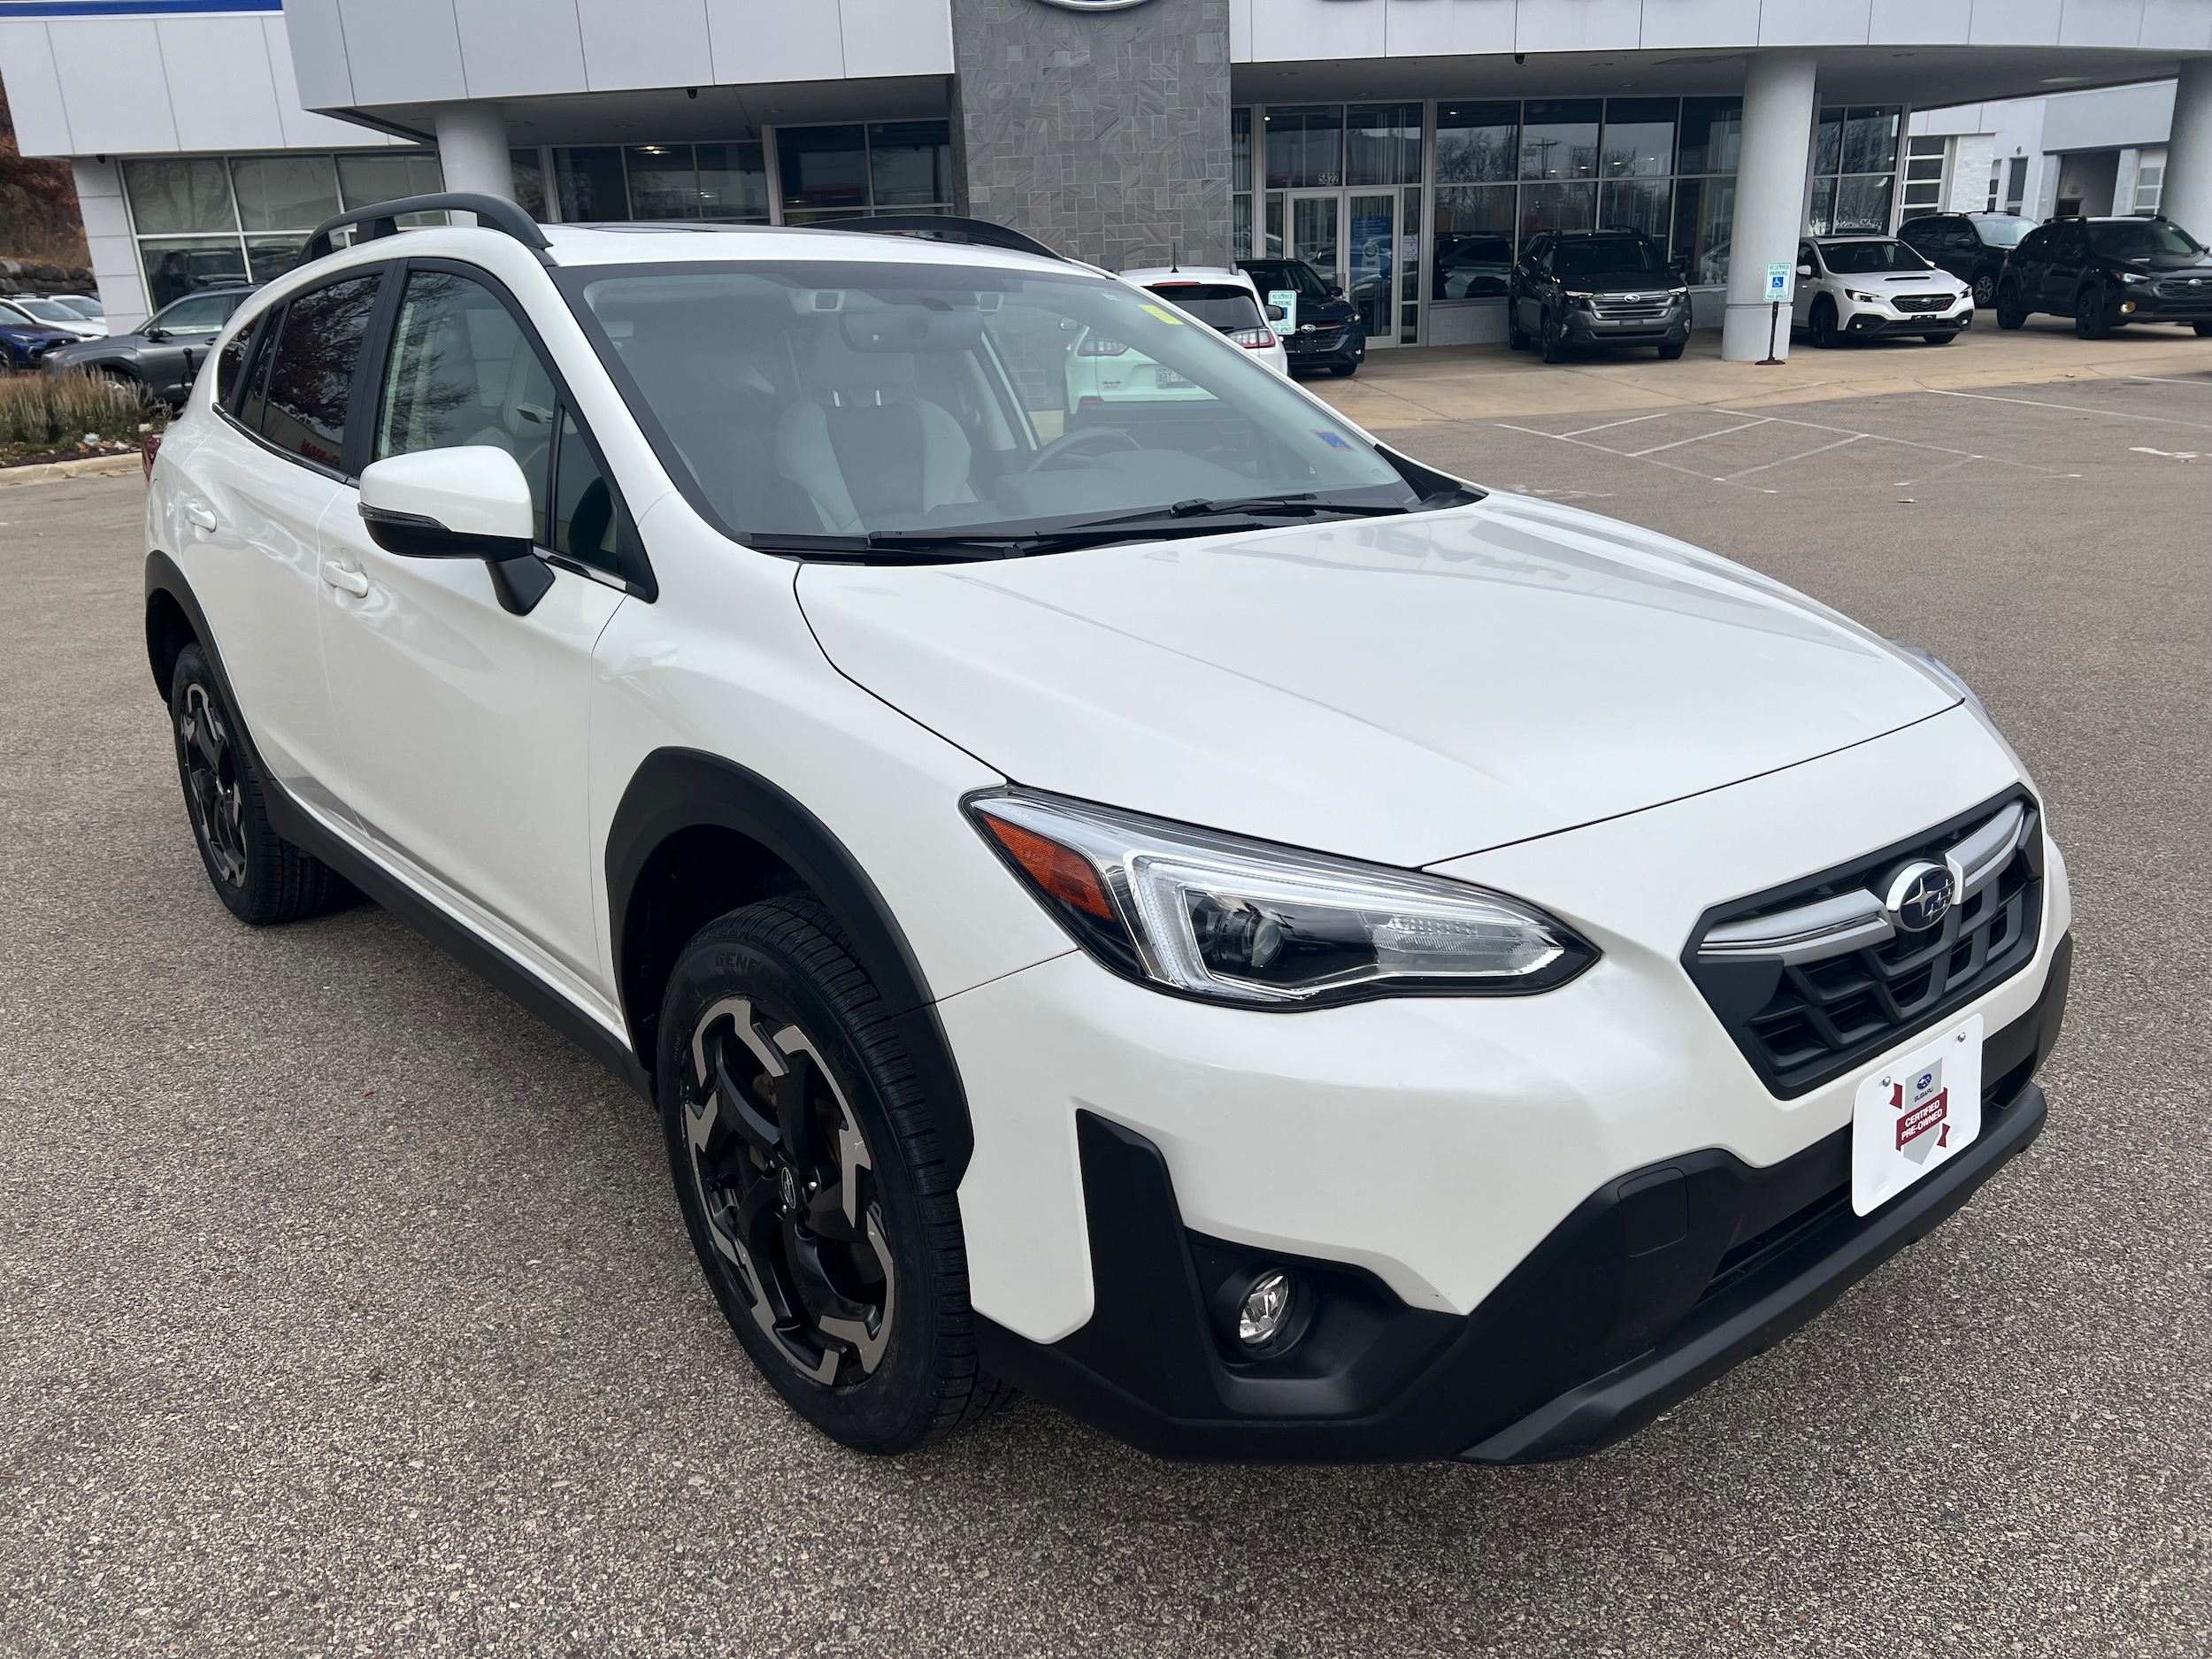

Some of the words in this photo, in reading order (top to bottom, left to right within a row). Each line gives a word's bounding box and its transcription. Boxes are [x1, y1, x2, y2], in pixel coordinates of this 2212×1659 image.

[1318, 173, 1339, 184] 5822
[1914, 1086, 1934, 1102] SUBARU
[1901, 1108, 1943, 1141] PRE-OWNED
[1904, 1099, 1940, 1128] CERTIFIED
